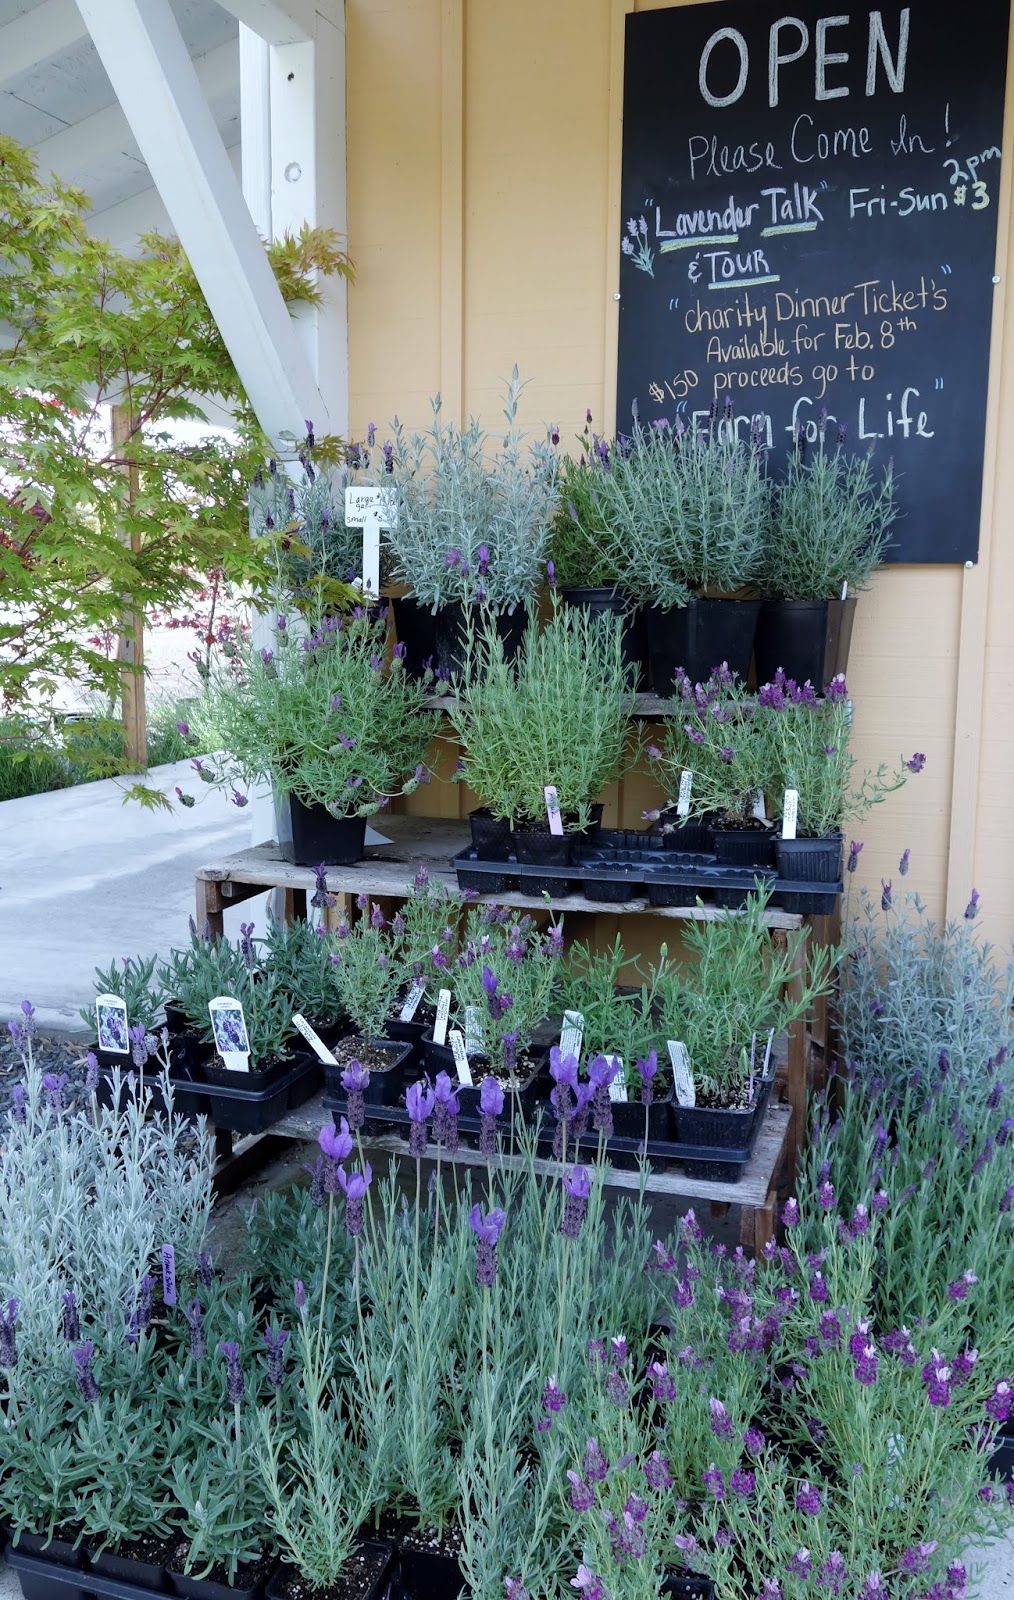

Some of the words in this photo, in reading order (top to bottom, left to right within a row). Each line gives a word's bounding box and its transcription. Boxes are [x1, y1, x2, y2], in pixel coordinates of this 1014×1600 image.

[699, 8, 910, 107] OPEN
[688, 134, 783, 180] Please
[791, 114, 873, 163] Come
[943, 146, 1002, 184] 2pm
[850, 185, 948, 218] Fri-Sun
[953, 181, 990, 210] $3
[775, 288, 854, 322] Dinner
[706, 327, 790, 363] Available
[791, 324, 825, 354] for
[835, 322, 874, 350] Feb.
[648, 369, 699, 403] $150
[714, 361, 803, 399] proceeds
[812, 365, 838, 399] go
[846, 355, 875, 381] to
[785, 397, 837, 442] for
[349, 492, 374, 506] Large
[346, 515, 367, 523] small
